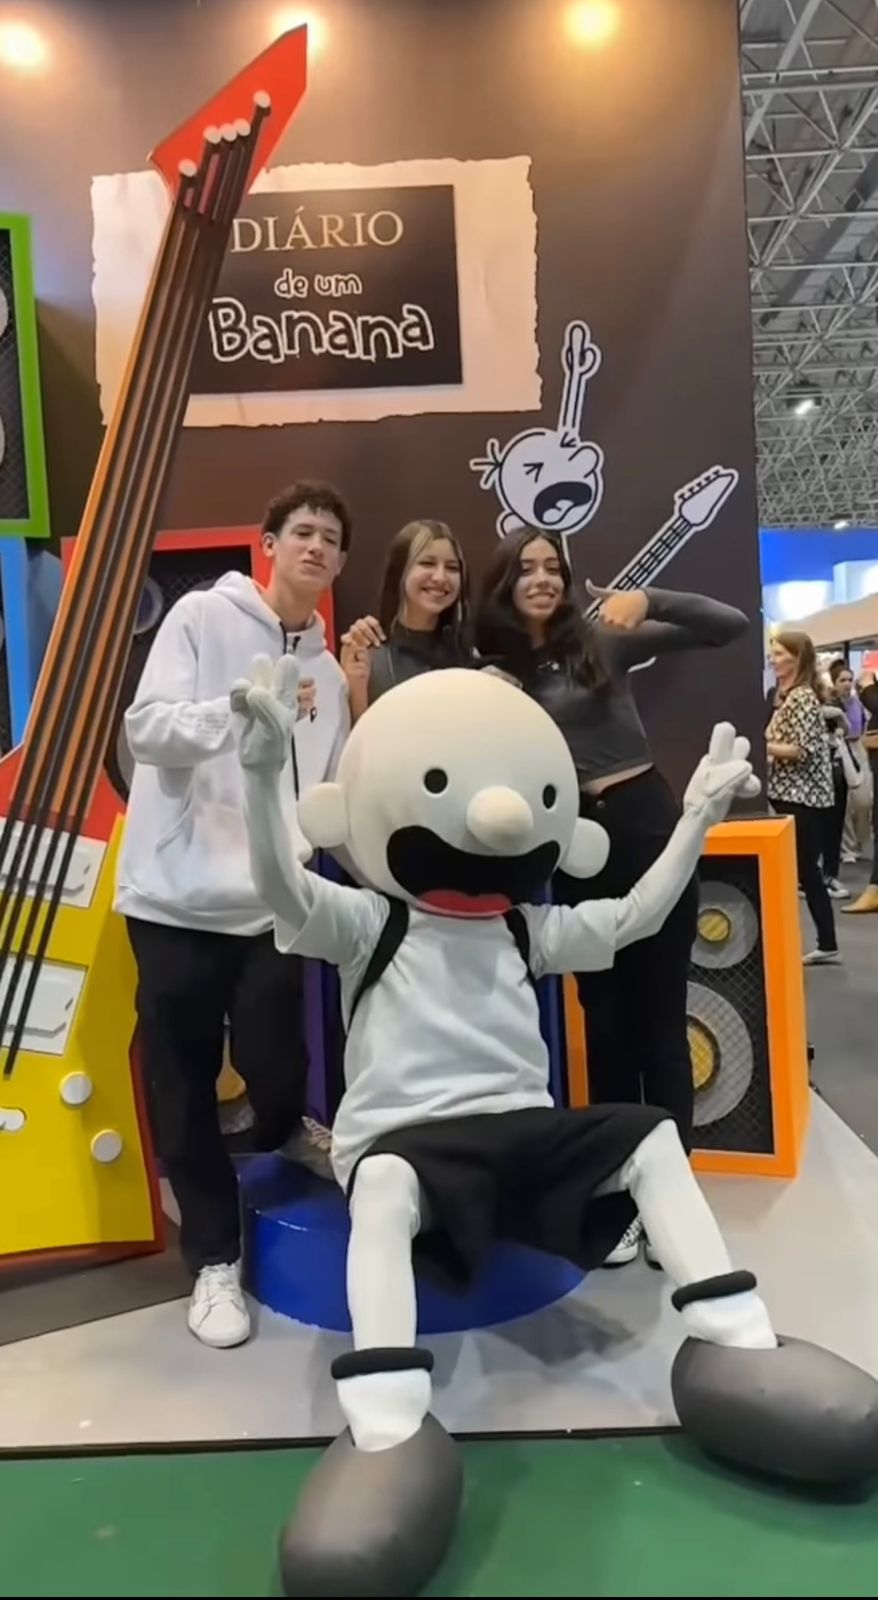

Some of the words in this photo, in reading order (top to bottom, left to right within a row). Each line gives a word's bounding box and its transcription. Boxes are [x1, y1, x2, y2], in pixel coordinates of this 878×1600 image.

[231, 206, 403, 252] DIÁRIO
[274, 268, 309, 298] de
[314, 273, 363, 297] um
[208, 297, 434, 363] Banana
